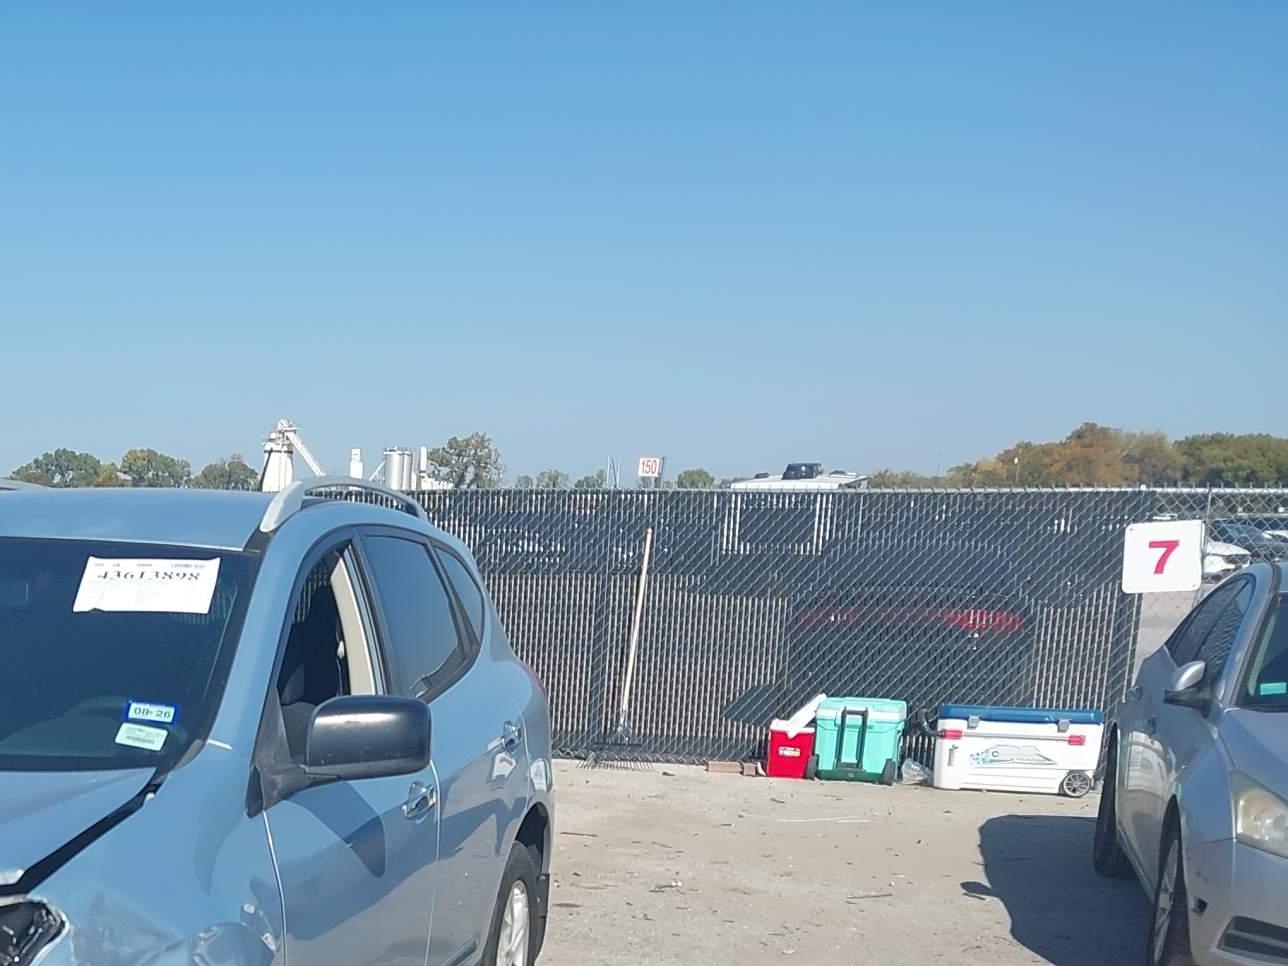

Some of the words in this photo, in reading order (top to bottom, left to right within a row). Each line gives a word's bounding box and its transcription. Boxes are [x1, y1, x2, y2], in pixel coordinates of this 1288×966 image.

[641, 459, 657, 474] 150
[1148, 539, 1180, 575] 7
[97, 570, 200, 581] 43613898
